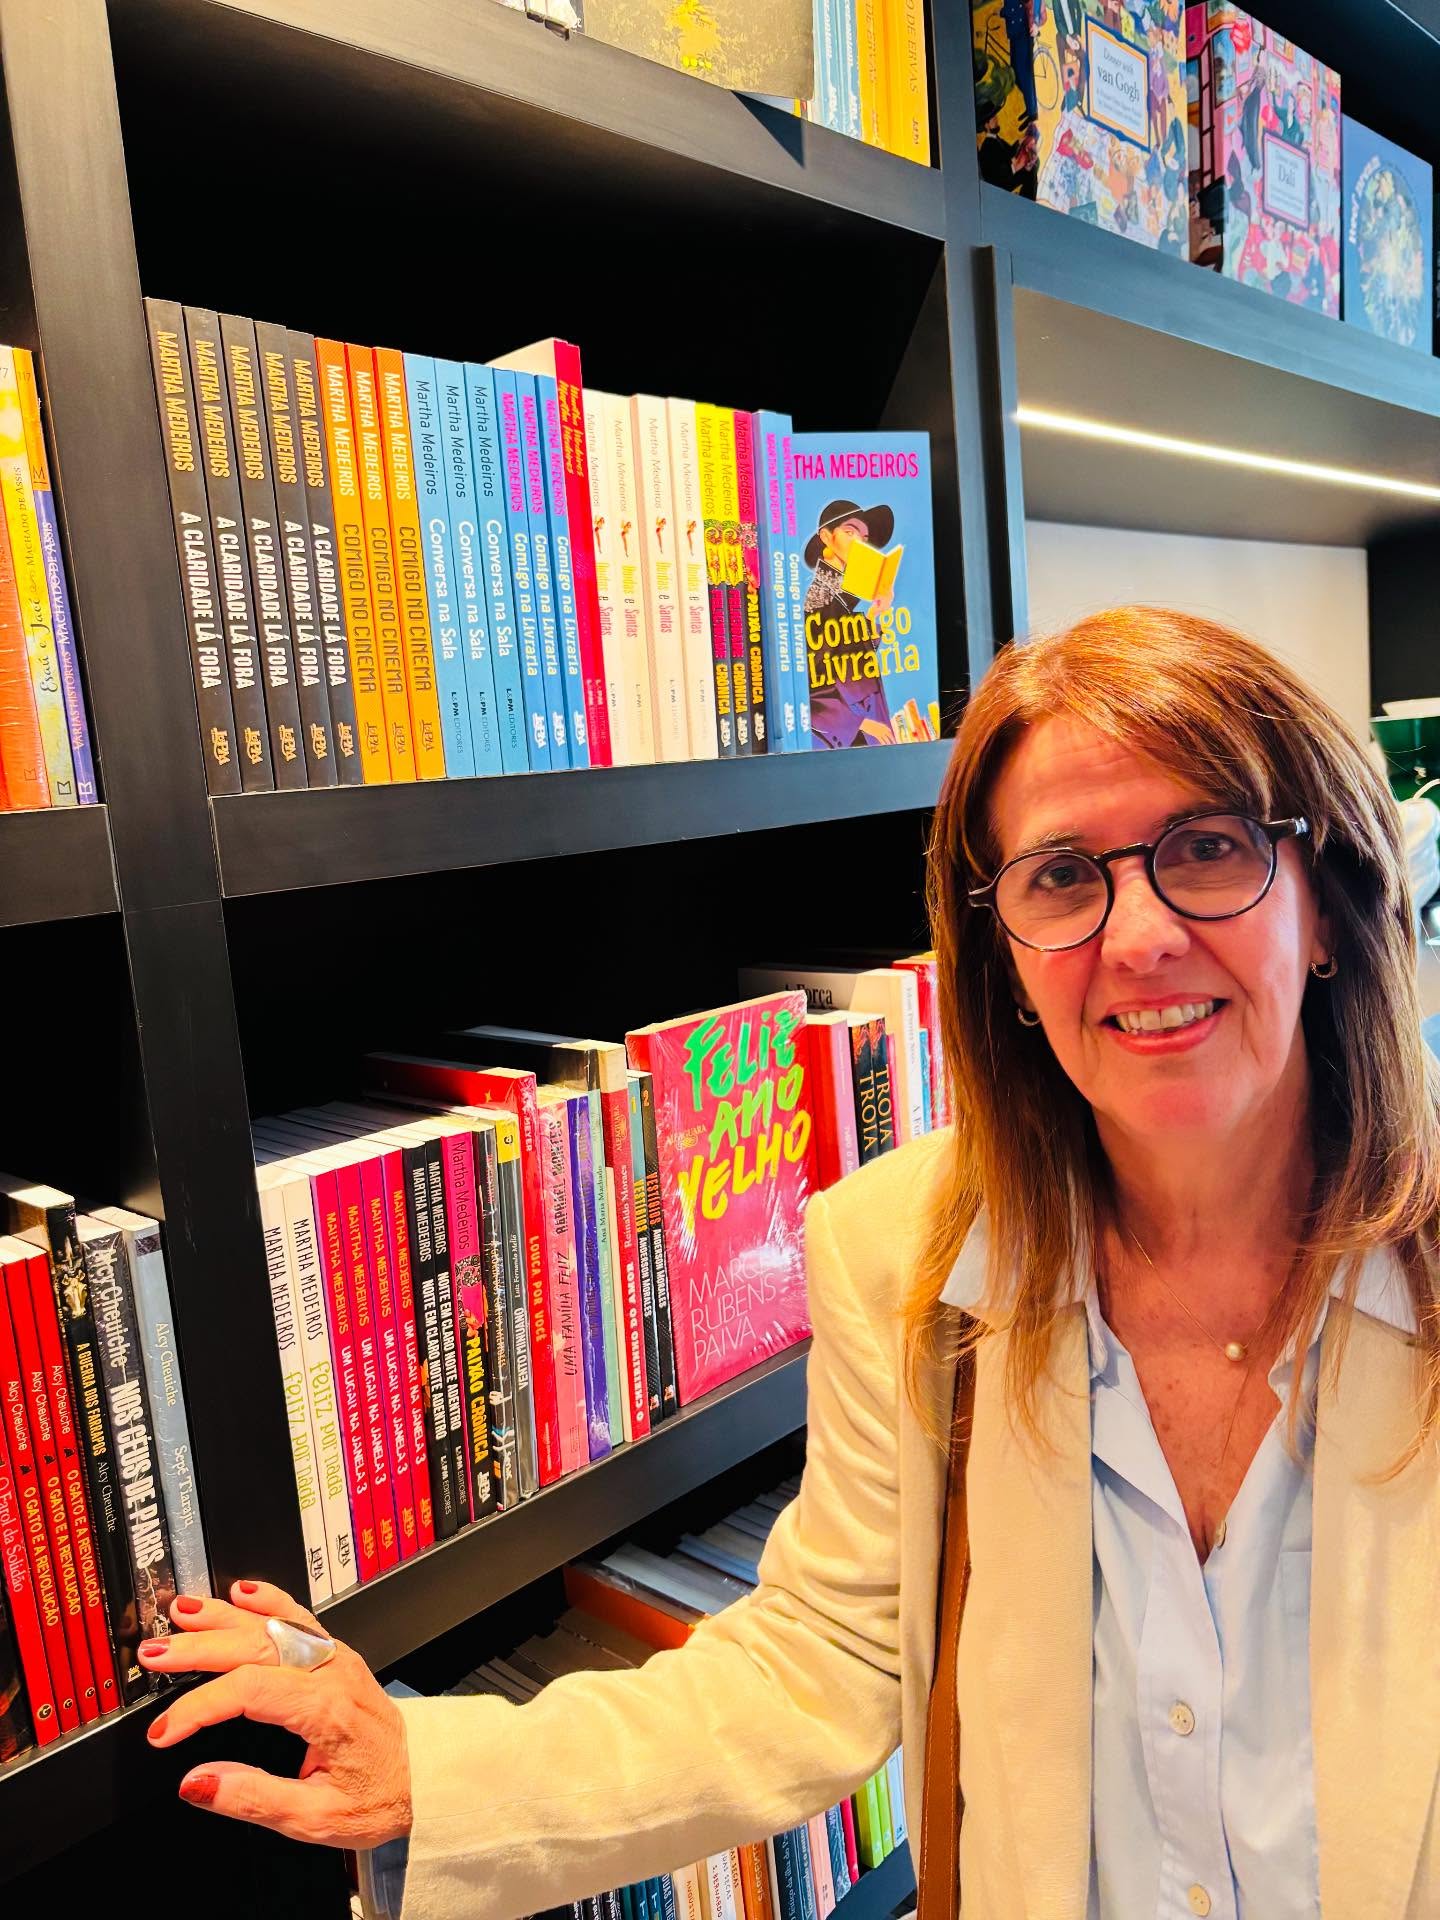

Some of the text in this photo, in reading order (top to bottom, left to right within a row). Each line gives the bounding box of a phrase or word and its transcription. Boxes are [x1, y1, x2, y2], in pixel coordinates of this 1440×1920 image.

[1097, 66, 1140, 101] van Gogh
[157, 331, 194, 472] MARTHA MEDEIROS
[195, 340, 230, 478] MARTHA MEDEIROS
[326, 365, 354, 496] MARTHA MEDEIROS
[416, 380, 437, 495] Martha Medeiros
[502, 392, 524, 512] MARTHA MEDEIROS
[700, 417, 717, 515] Martha Medeiros
[736, 420, 750, 514] Martha Medeiros
[794, 453, 918, 480] THA MEDEIROS
[180, 511, 223, 689] A CLARIDADE LÁ FORA
[216, 516, 256, 689] A CLARIDADE LÁ FORA
[343, 524, 376, 694] COMIGO NO CINEMA
[429, 518, 458, 660] Conversa na Sala
[515, 533, 538, 676] Comigo na Livraria
[659, 605, 674, 633] Santas
[774, 552, 789, 672] Comigo na Livraria
[805, 607, 911, 651] Comigo
[808, 644, 920, 688] Livraria
[860, 1070, 877, 1151] TROIA
[876, 1064, 893, 1144] TROIA
[413, 1167, 431, 1263] MARTHA MEDEIROS
[452, 1141, 472, 1250] Martha Medeiros
[599, 1203, 607, 1226] Maria
[620, 1165, 632, 1248] Reinaldo Moraes
[677, 1110, 811, 1237] VELHO
[293, 1219, 323, 1341] MARTHA MEDEIROS
[326, 1212, 348, 1335] MARTHA MEDEIROS
[529, 1235, 541, 1277] LOUCA
[533, 1281, 543, 1306] POR
[653, 1229, 666, 1308] ANDERSON MORALES
[101, 1286, 130, 1368] Cheuiche
[514, 1308, 528, 1390] VENTO MINUANO
[557, 1252, 578, 1376] UMA FAMÍLIA FELIZ
[626, 1262, 645, 1421] O CHEIRINHO DO AMOR
[691, 1273, 776, 1339] RUBENS
[693, 1317, 756, 1371] PAIVA
[77, 1343, 107, 1457] A GUERRA DOS FARRAPOS
[156, 1323, 176, 1407] Alcy Cheuiche
[422, 1279, 447, 1440] NOITE EM CLARO NOITE ADENTRO
[466, 1336, 489, 1464] PAIXÃO CRÔNICA
[8, 1381, 27, 1451] Alcy Cheuiche
[174, 1445, 188, 1475] Sepé
[320, 1426, 336, 1451] por
[341, 1346, 368, 1494] UM LUGAR NA JANELA 3
[97, 1460, 117, 1532] Alcy Cheuiche
[110, 1380, 164, 1570] NOS CÉUS DE PARIS
[324, 1457, 343, 1500] nada
[3, 1529, 18, 1545] da
[7, 1544, 26, 1592] Solidão
[24, 1487, 58, 1627] O GATO E A REVOLUÇÃO
